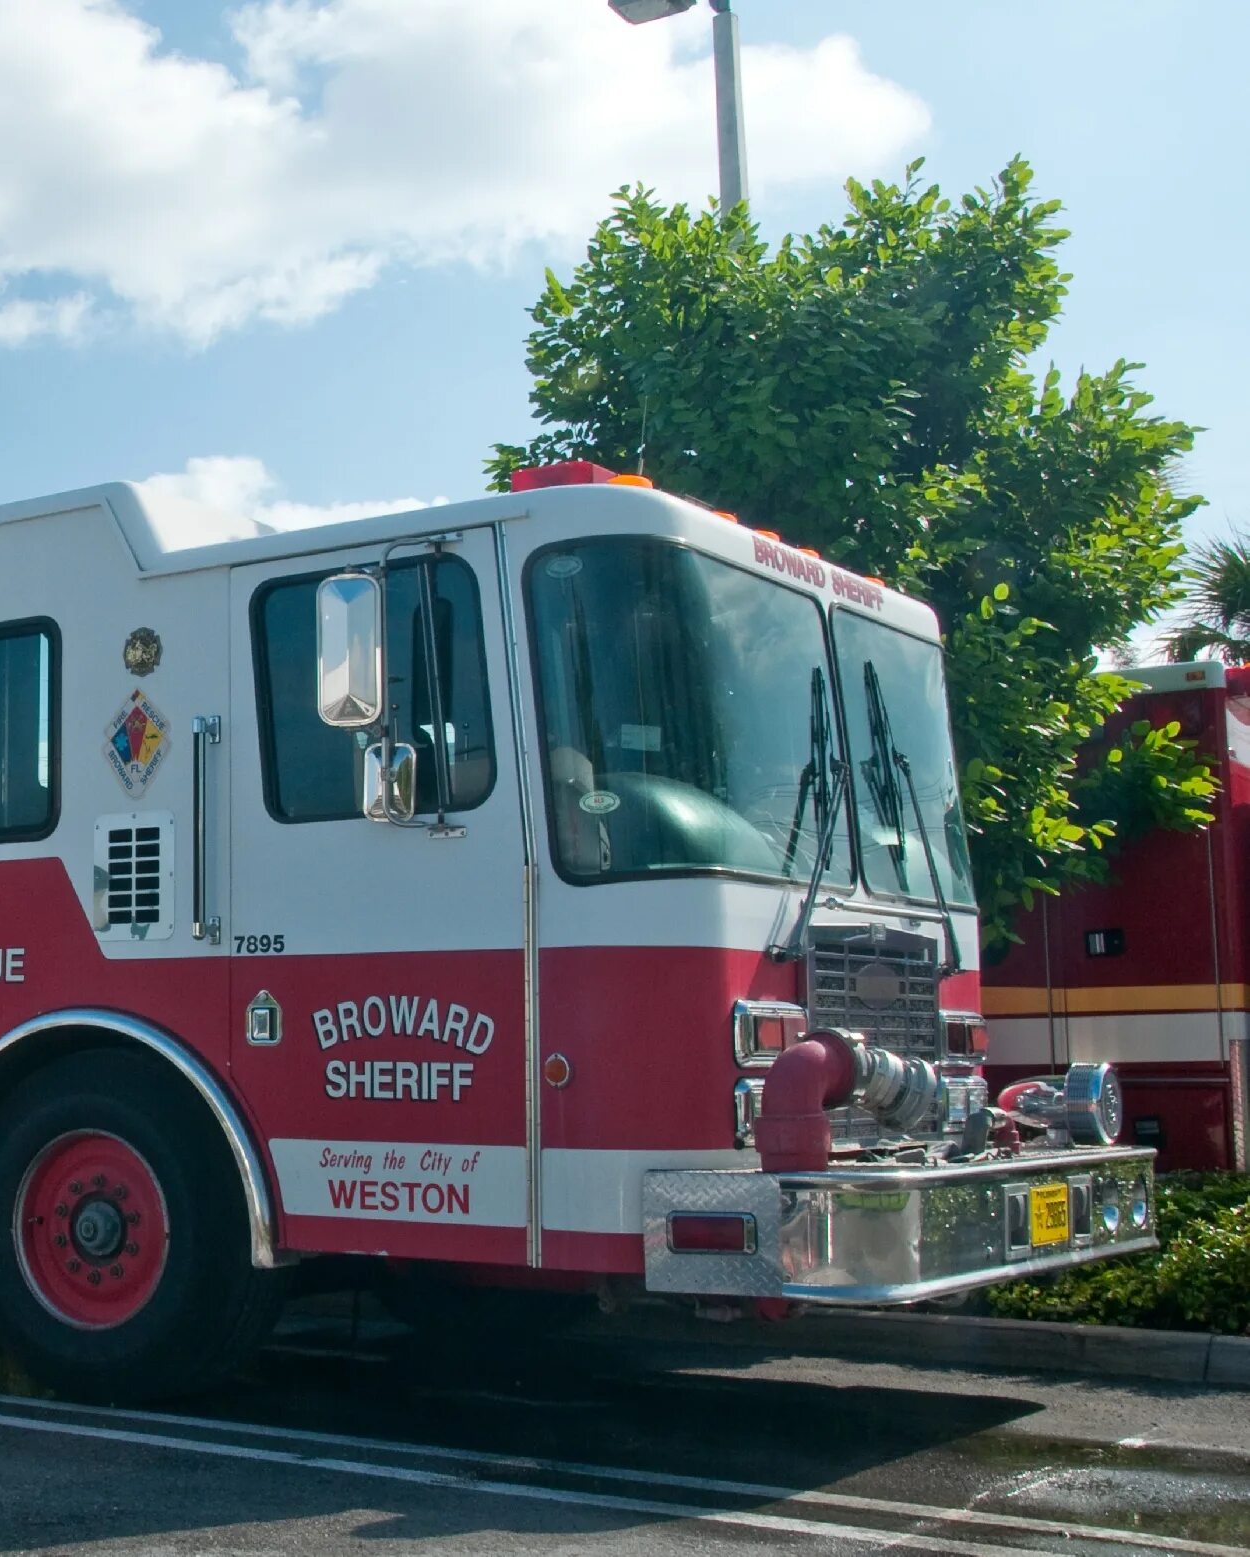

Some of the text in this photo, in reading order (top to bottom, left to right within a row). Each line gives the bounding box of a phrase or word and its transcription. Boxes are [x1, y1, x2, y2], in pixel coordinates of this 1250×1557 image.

[752, 535, 884, 611] BROWARD SHERIFF
[113, 701, 166, 731] FIRE RESCUE
[108, 749, 162, 790] BROWARD SHERIFF
[130, 764, 142, 773] FL
[234, 934, 285, 954] 7895
[313, 995, 495, 1055] BROWARD
[325, 1060, 474, 1101] SHERIFF
[319, 1147, 480, 1176] Serving the City of
[328, 1179, 470, 1215] WESTON
